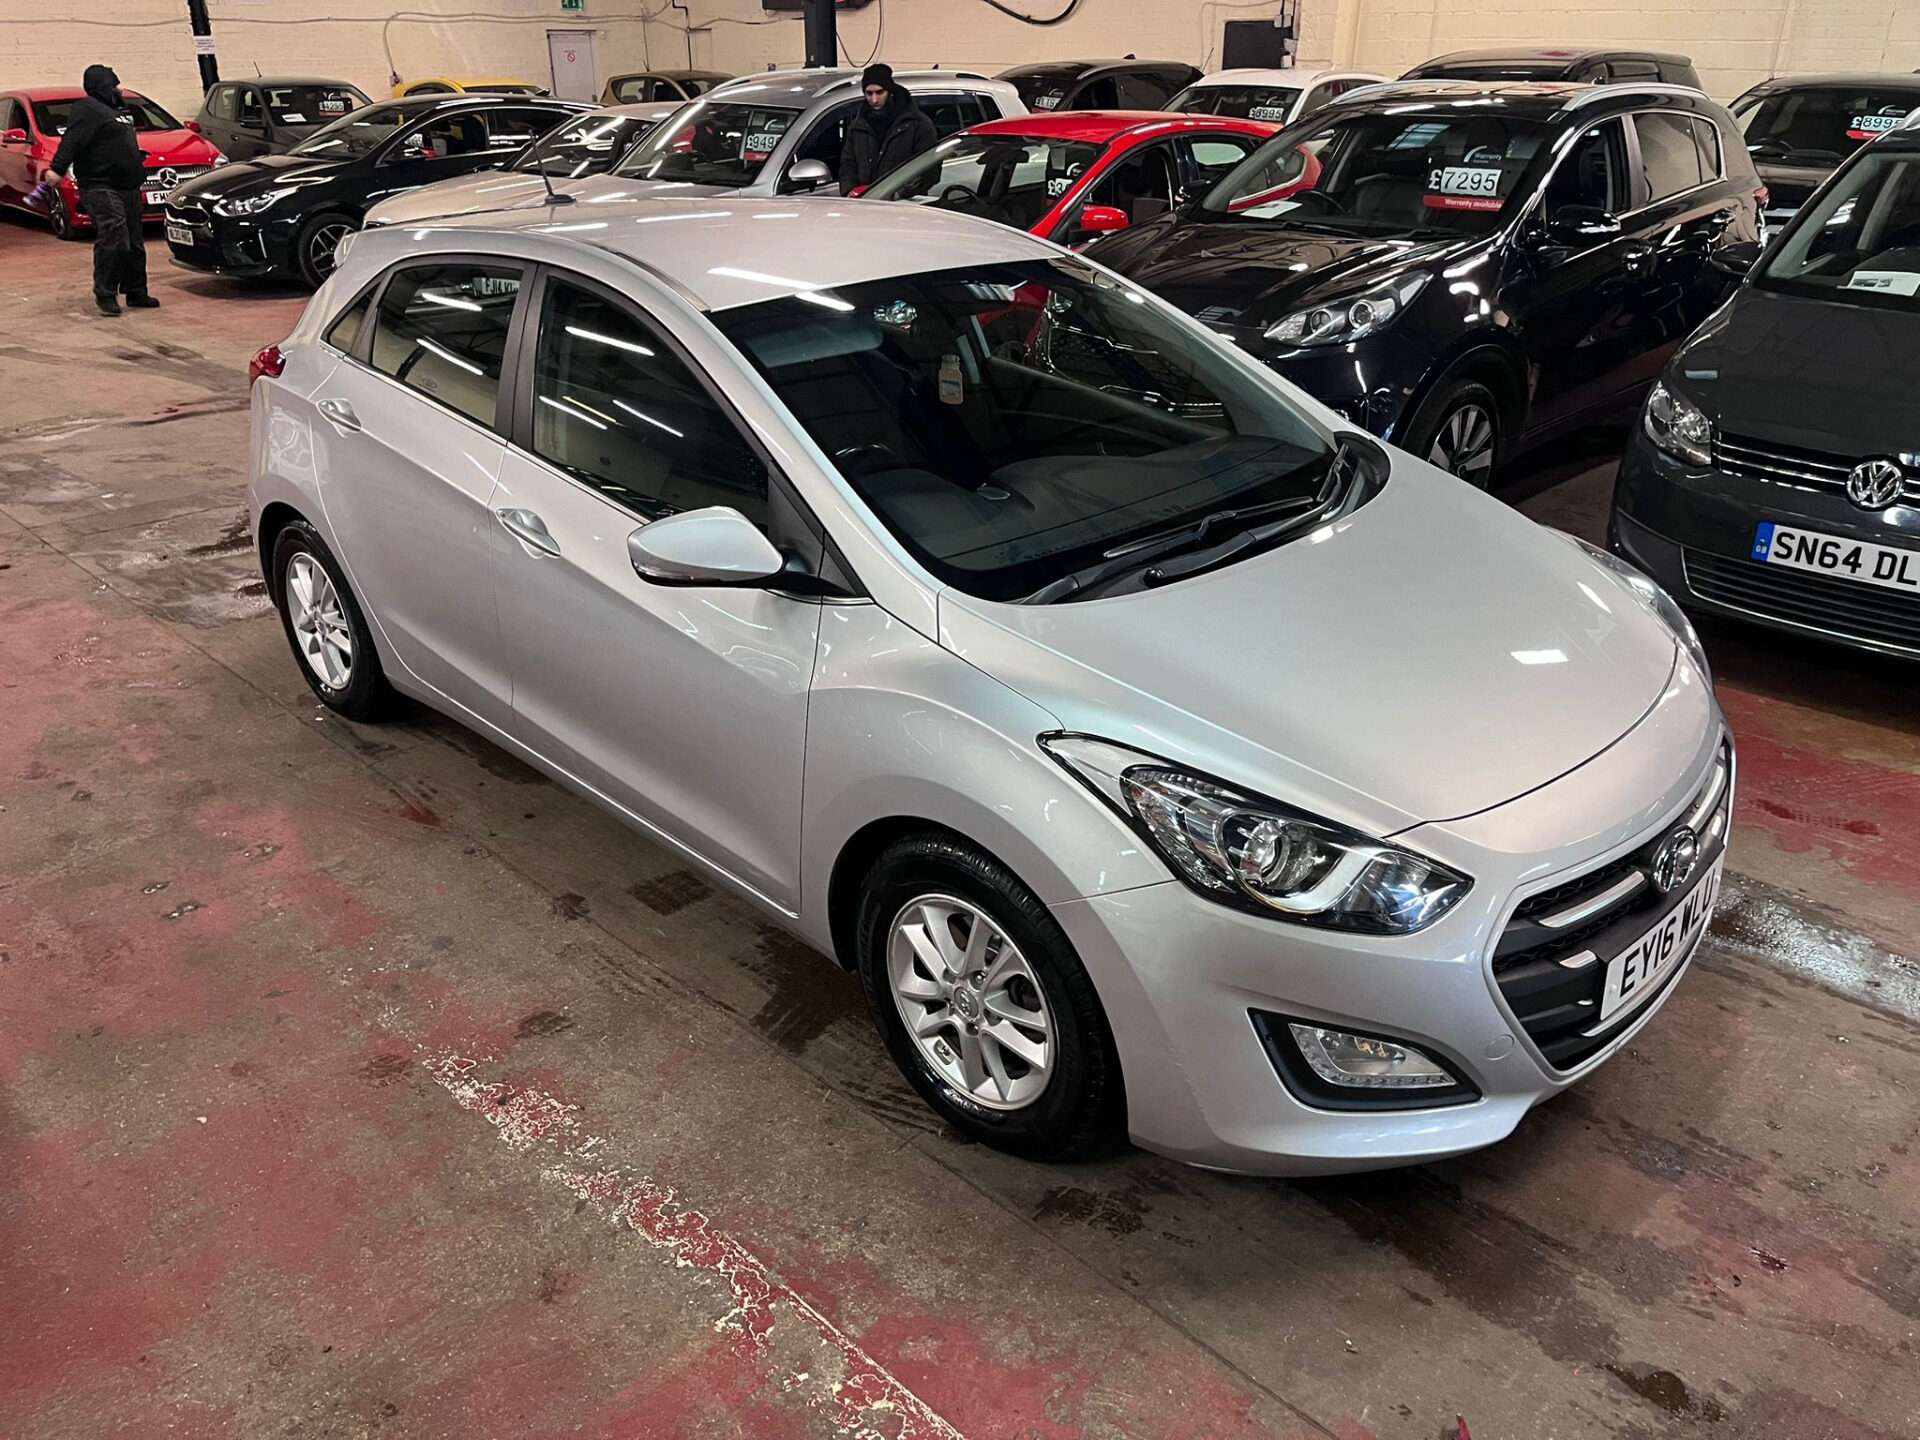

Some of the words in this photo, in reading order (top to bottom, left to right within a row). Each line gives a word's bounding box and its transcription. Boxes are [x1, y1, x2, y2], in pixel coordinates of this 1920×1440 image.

[746, 135, 778, 149] £949
[1428, 169, 1497, 191] £7295
[1773, 531, 1863, 574] SN64
[1619, 915, 1677, 998] EY16
[1679, 867, 1716, 943] WLU
